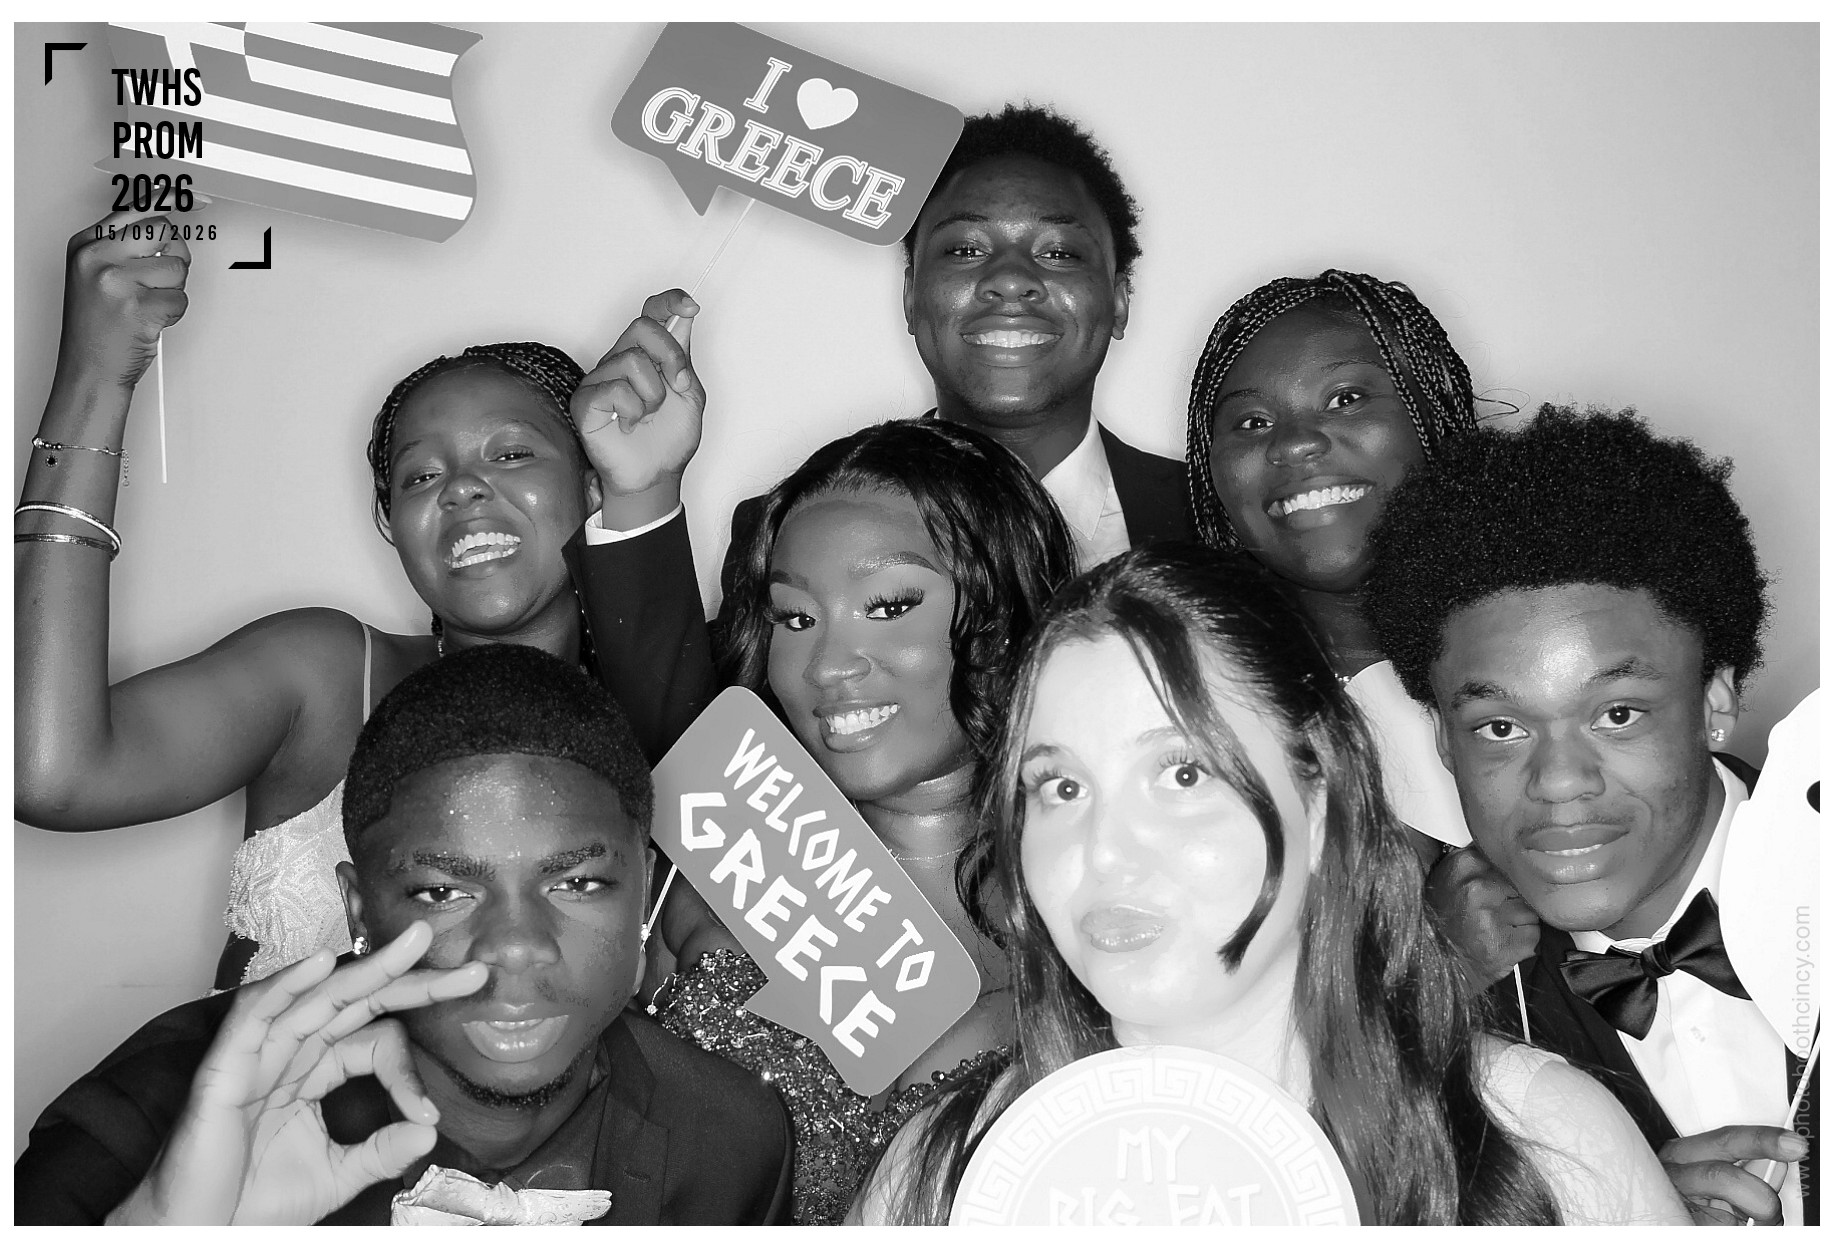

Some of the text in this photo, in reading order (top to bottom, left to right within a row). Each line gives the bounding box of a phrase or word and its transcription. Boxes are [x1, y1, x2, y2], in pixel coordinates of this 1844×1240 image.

[743, 56, 793, 114] I
[641, 86, 906, 229] GREECE
[723, 728, 935, 993] WELCOME TO
[680, 791, 896, 1058] GREECE
[1117, 1125, 1191, 1184] MY
[1167, 1183, 1262, 1226] FAT
